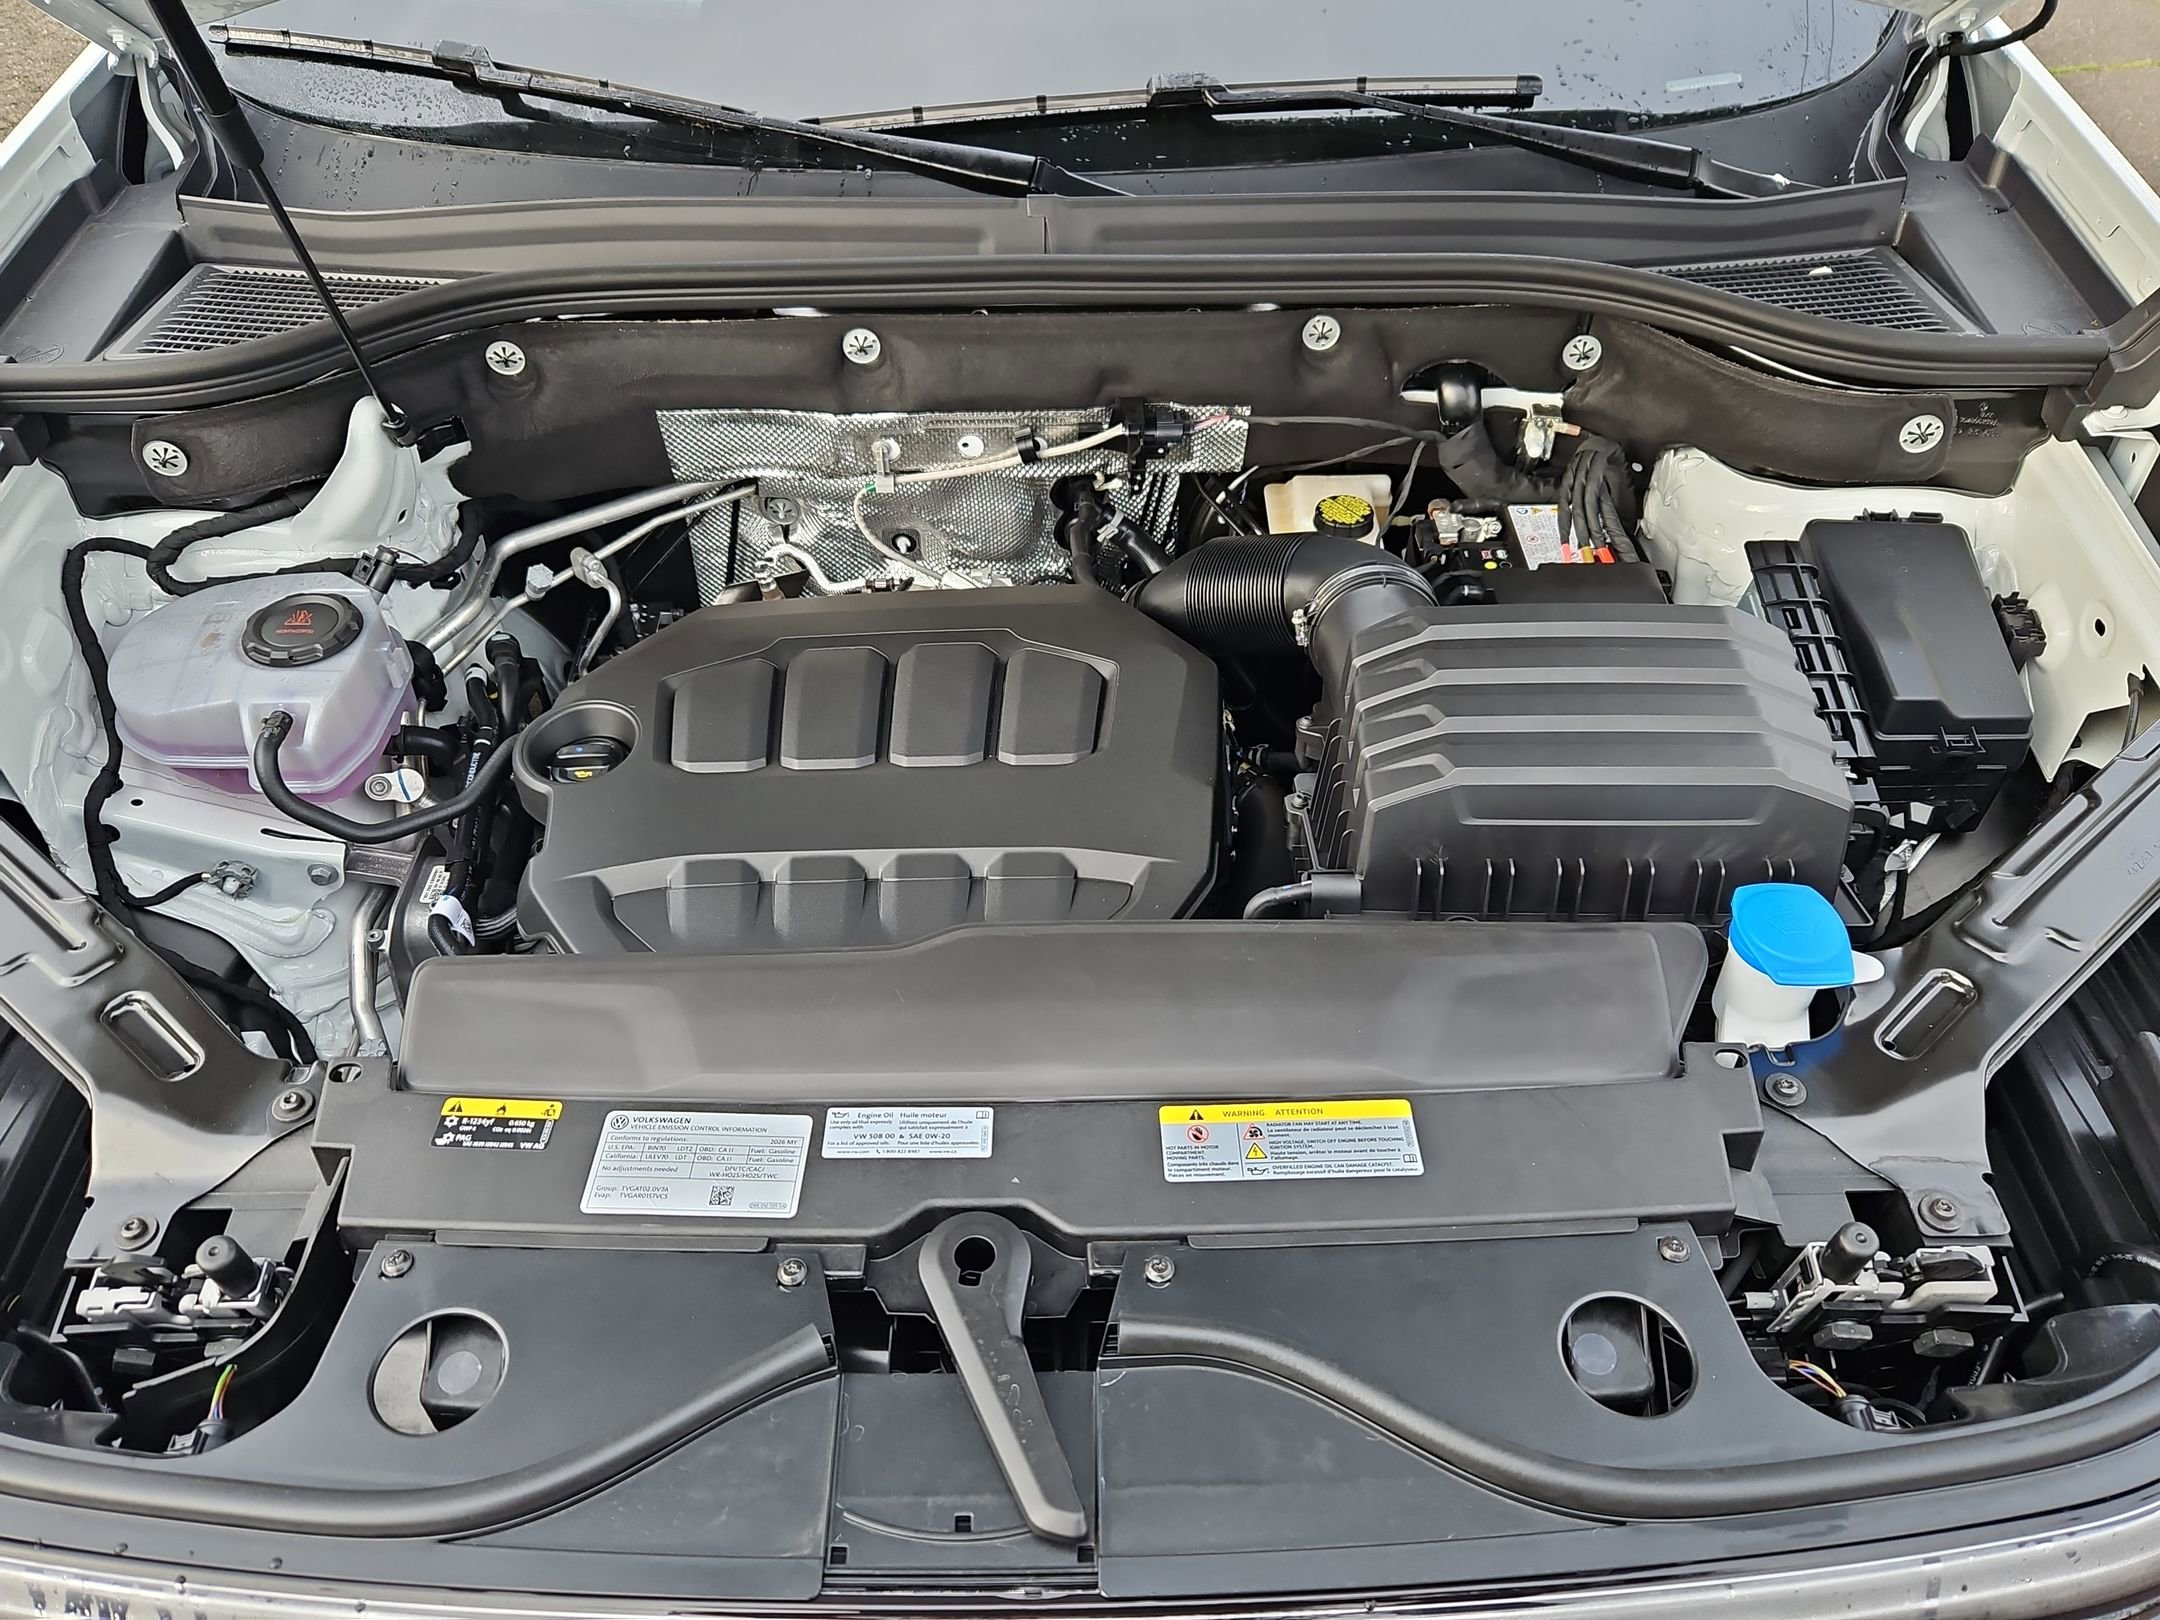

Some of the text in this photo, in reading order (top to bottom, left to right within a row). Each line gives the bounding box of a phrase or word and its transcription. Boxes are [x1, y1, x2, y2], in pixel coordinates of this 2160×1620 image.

[1223, 1109, 1264, 1117] WARNING
[461, 1117, 496, 1127] R-1234yf
[633, 1116, 691, 1124] VOLKSWAGEN
